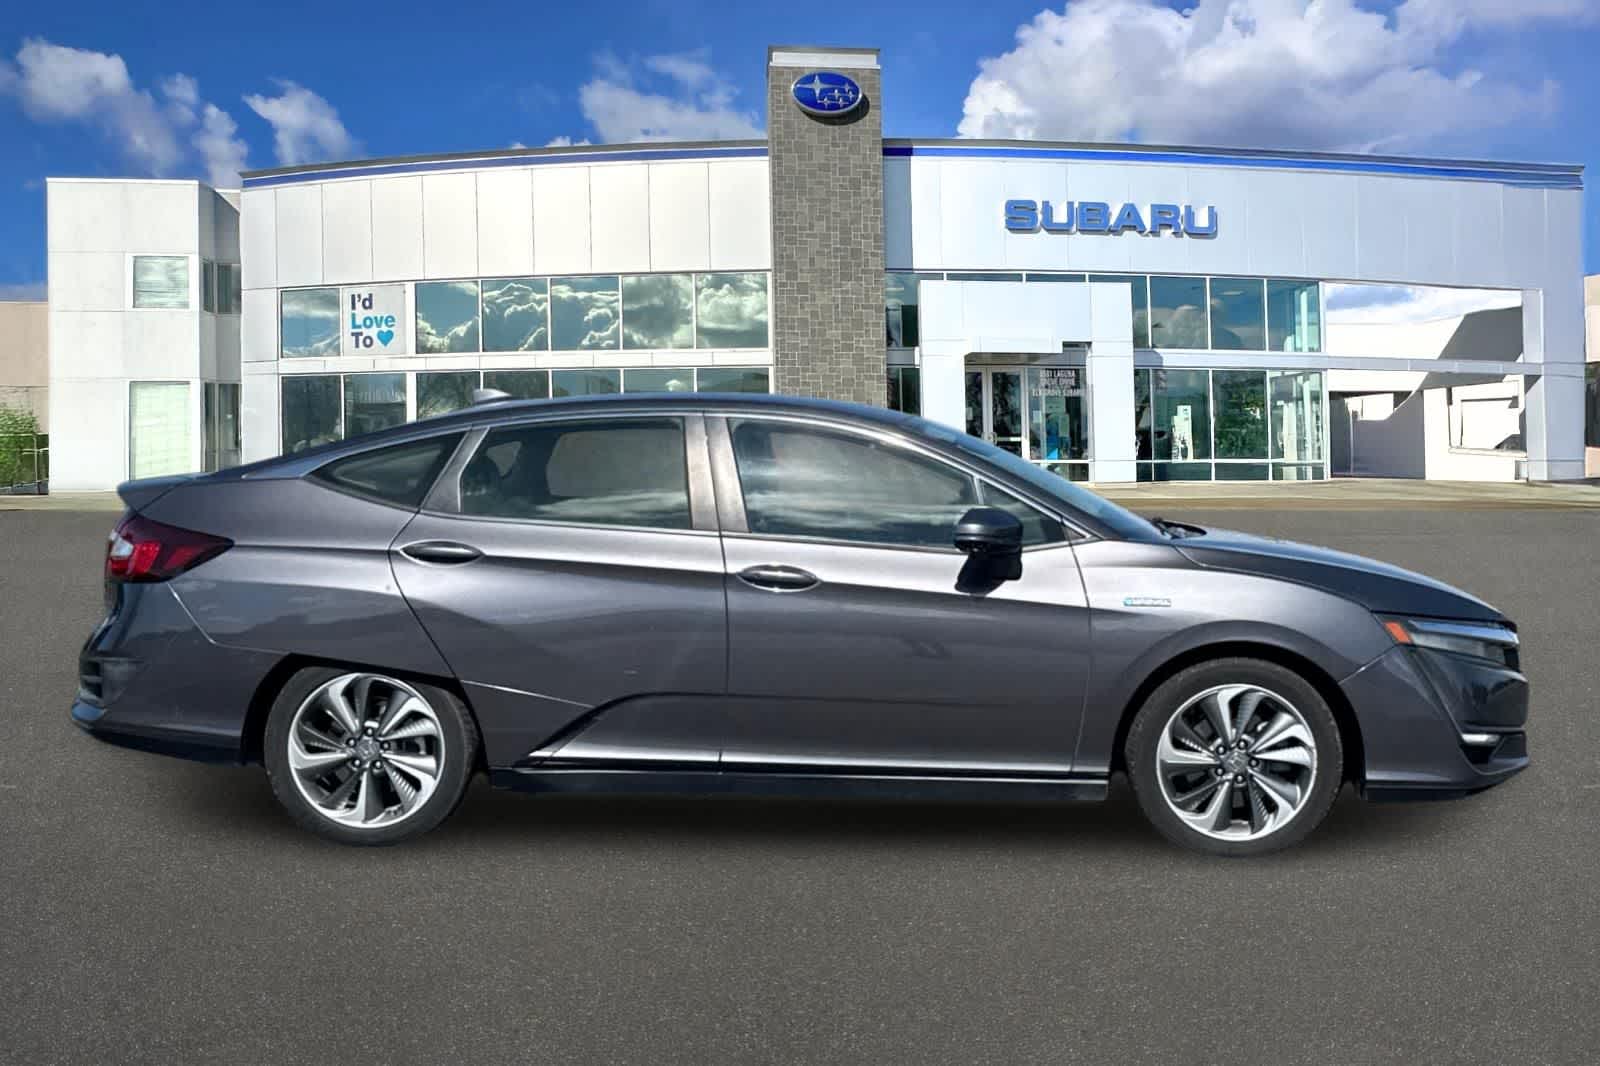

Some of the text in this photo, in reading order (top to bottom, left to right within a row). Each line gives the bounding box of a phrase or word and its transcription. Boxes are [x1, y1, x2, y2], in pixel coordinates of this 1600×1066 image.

[1005, 199, 1218, 238] SUBARU
[351, 293, 373, 310] I'd
[351, 312, 396, 329] Love
[350, 331, 374, 348] To
